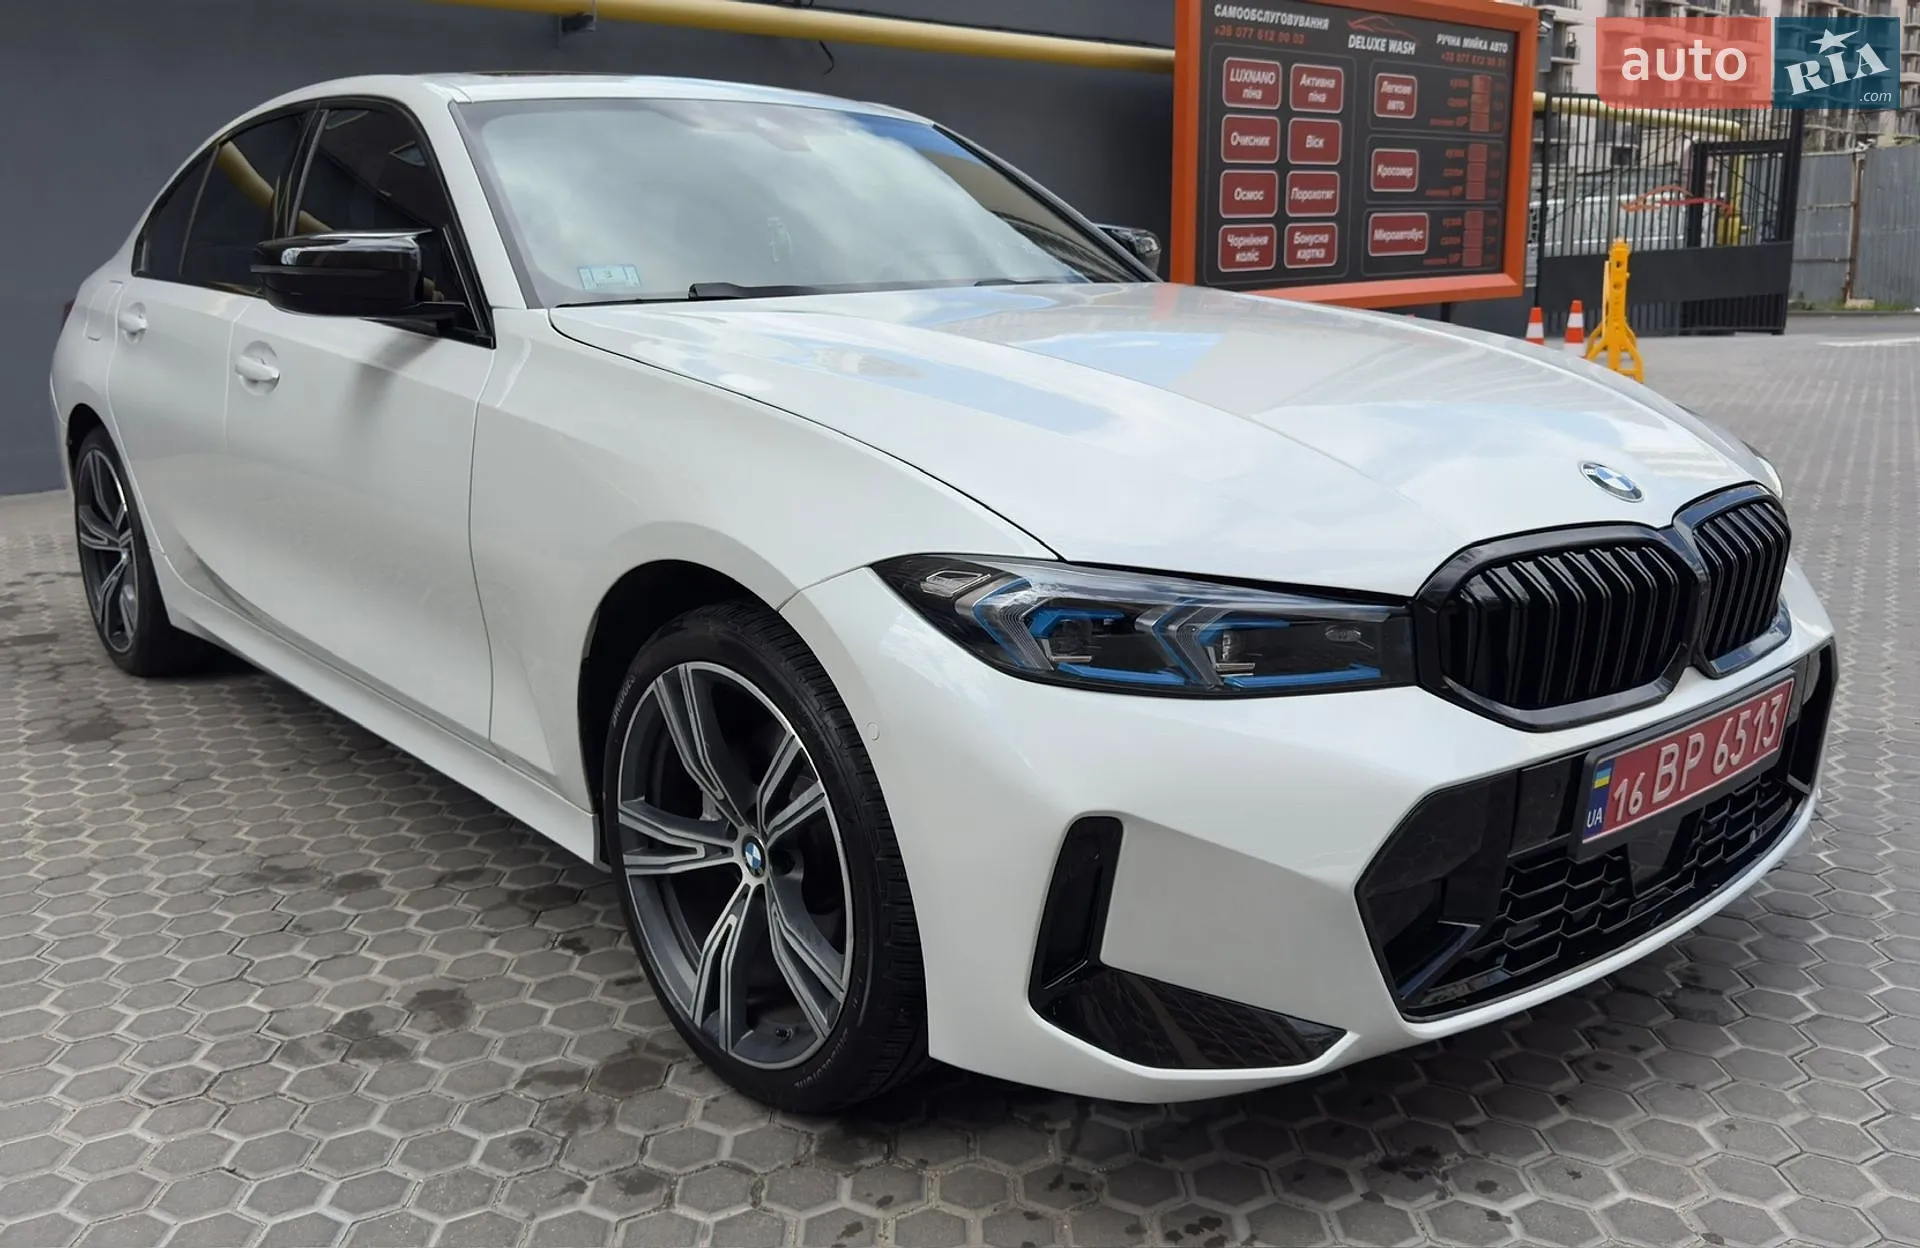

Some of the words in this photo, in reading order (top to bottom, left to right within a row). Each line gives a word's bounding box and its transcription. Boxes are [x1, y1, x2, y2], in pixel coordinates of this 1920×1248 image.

[1214, 4, 1330, 31] САМООБСЛУГОВУВАННЯ
[1348, 34, 1388, 53] DELUXE
[1388, 39, 1416, 55] WASH
[1436, 33, 1462, 47] РУЧНА
[1462, 37, 1488, 51] МИЙКА
[1489, 41, 1509, 53] АВТО
[1229, 68, 1276, 85] LUXNANO
[1300, 74, 1336, 89] Активна
[1242, 86, 1263, 100] піна
[1308, 90, 1327, 103] піна
[1230, 132, 1271, 147] Очисник
[1305, 135, 1325, 149] Віск
[1233, 187, 1265, 201] Осмос
[1293, 231, 1330, 247] Бонусна
[1235, 249, 1260, 264] коліс
[1296, 247, 1326, 262] картка
[1613, 771, 1646, 822] 16
[1651, 732, 1705, 805] BP
[1711, 693, 1784, 776] 6513
[1586, 807, 1604, 829] UA
